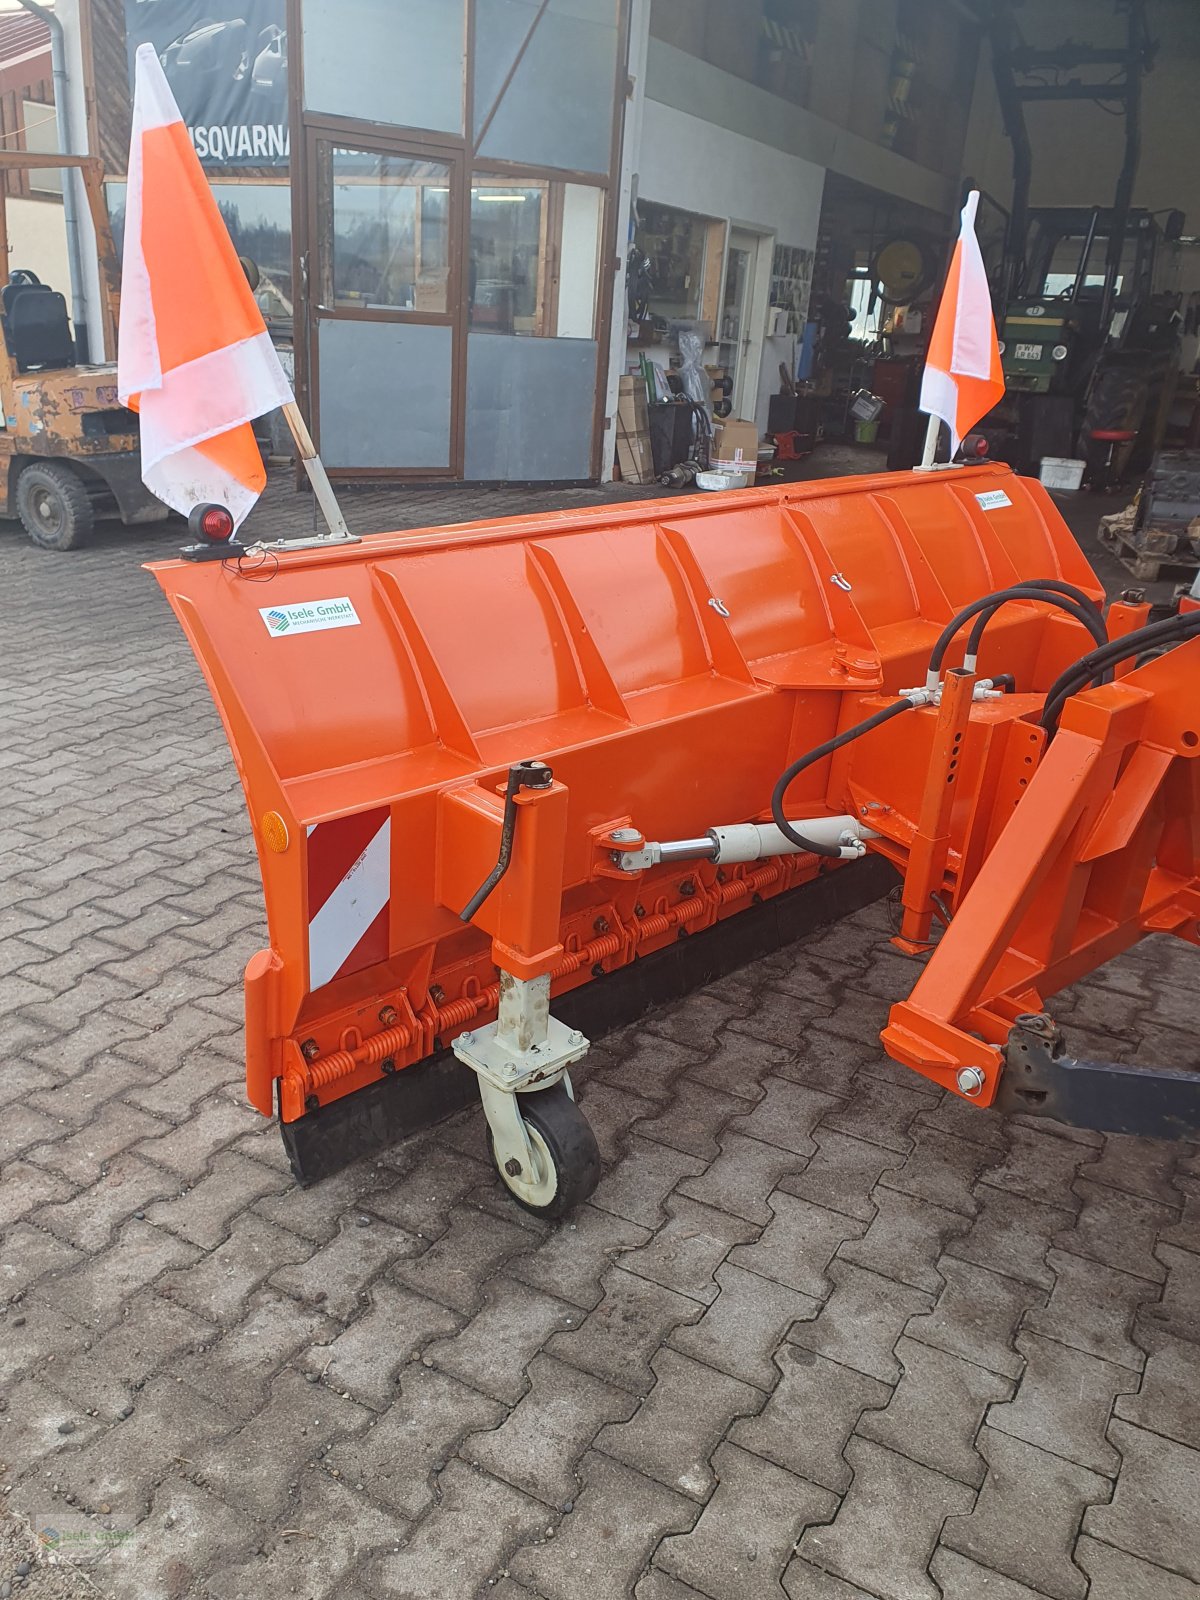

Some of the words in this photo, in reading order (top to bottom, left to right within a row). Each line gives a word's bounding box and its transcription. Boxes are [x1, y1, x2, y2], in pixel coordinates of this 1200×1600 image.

[287, 608, 315, 620] Isele
[316, 602, 352, 616] GmbH
[292, 617, 327, 626] MECHANISCHE
[327, 613, 355, 621] WERKSTATT
